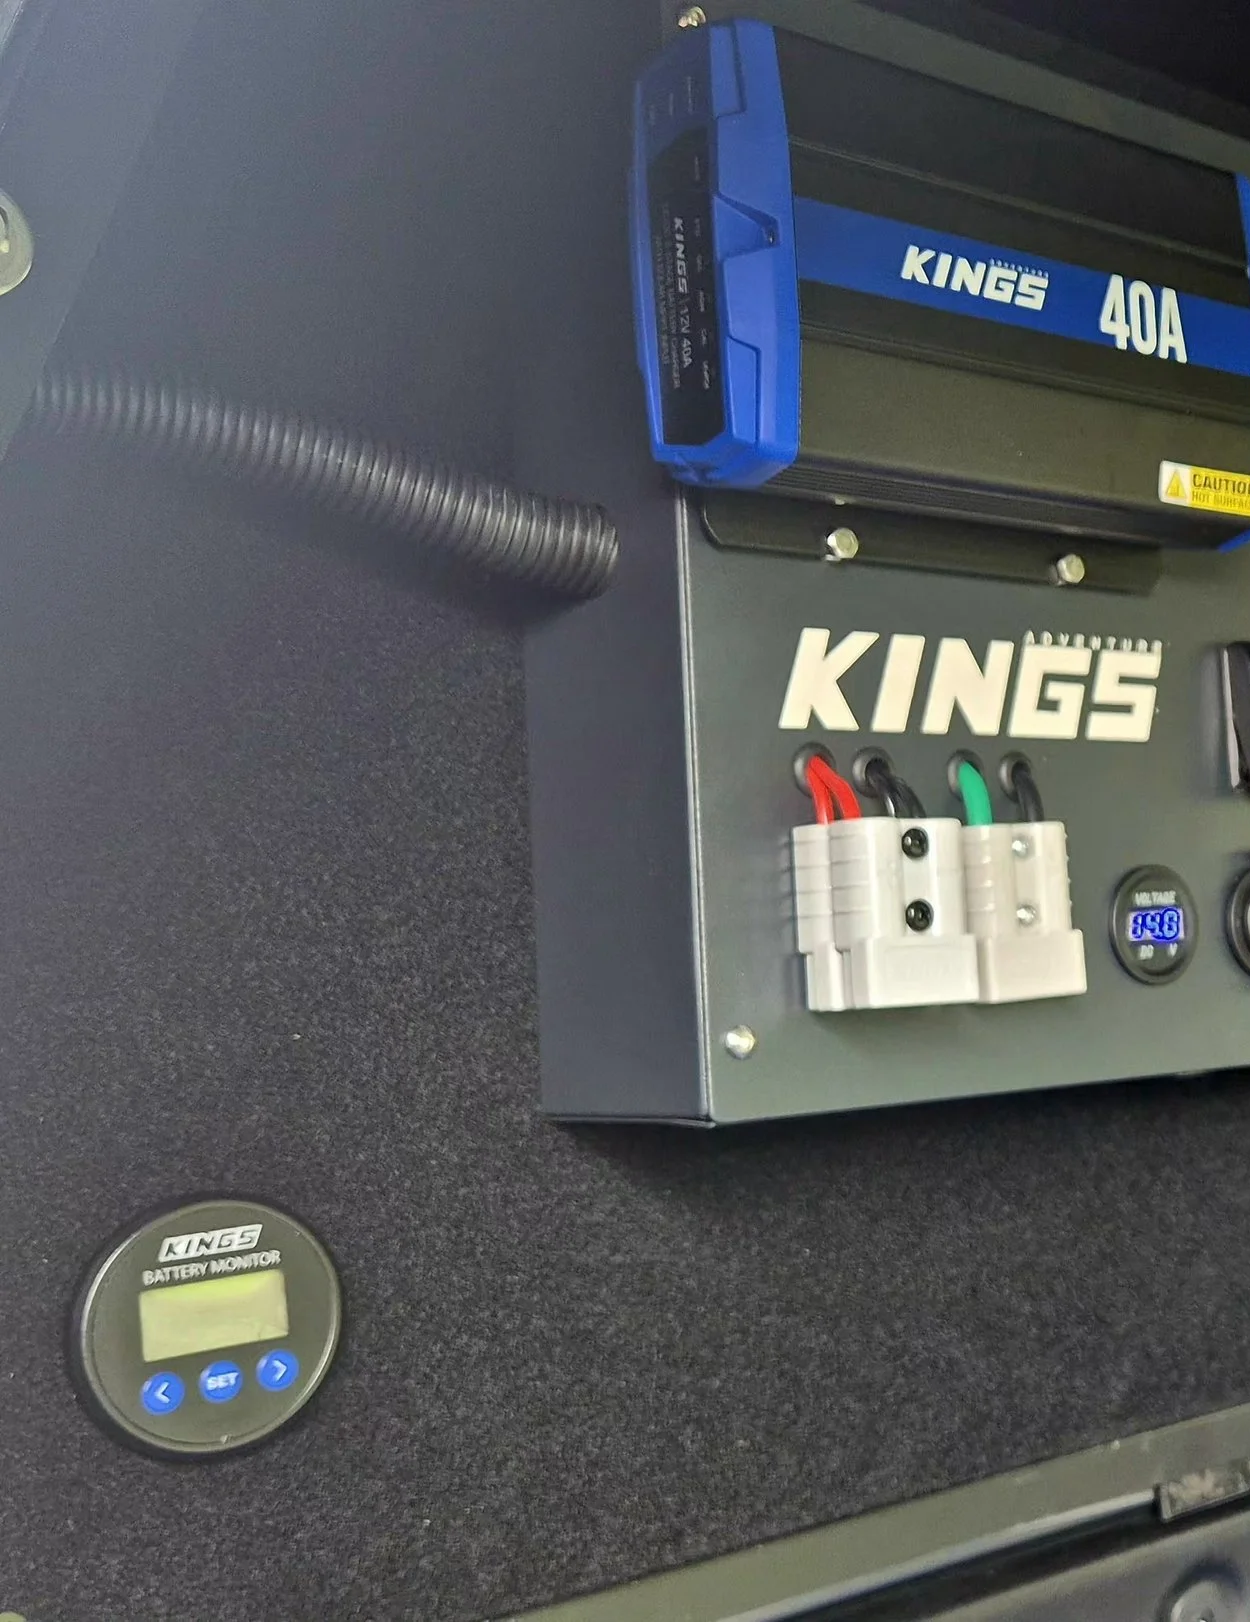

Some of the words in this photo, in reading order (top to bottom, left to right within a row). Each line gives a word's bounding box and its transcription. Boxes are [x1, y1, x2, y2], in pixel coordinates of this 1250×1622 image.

[673, 217, 688, 293] KINGS
[900, 244, 1049, 311] KINGS
[680, 305, 690, 333] 12V
[1098, 273, 1188, 363] 40A
[682, 338, 692, 368] 40A
[1191, 490, 1211, 504] HOT
[778, 627, 1162, 743] KINGS
[1134, 890, 1177, 906] VOLTAGE
[159, 1224, 263, 1262] KINGS
[142, 1260, 209, 1286] BATTERY
[209, 1250, 282, 1276] MONITOR
[207, 1372, 239, 1391] SET
